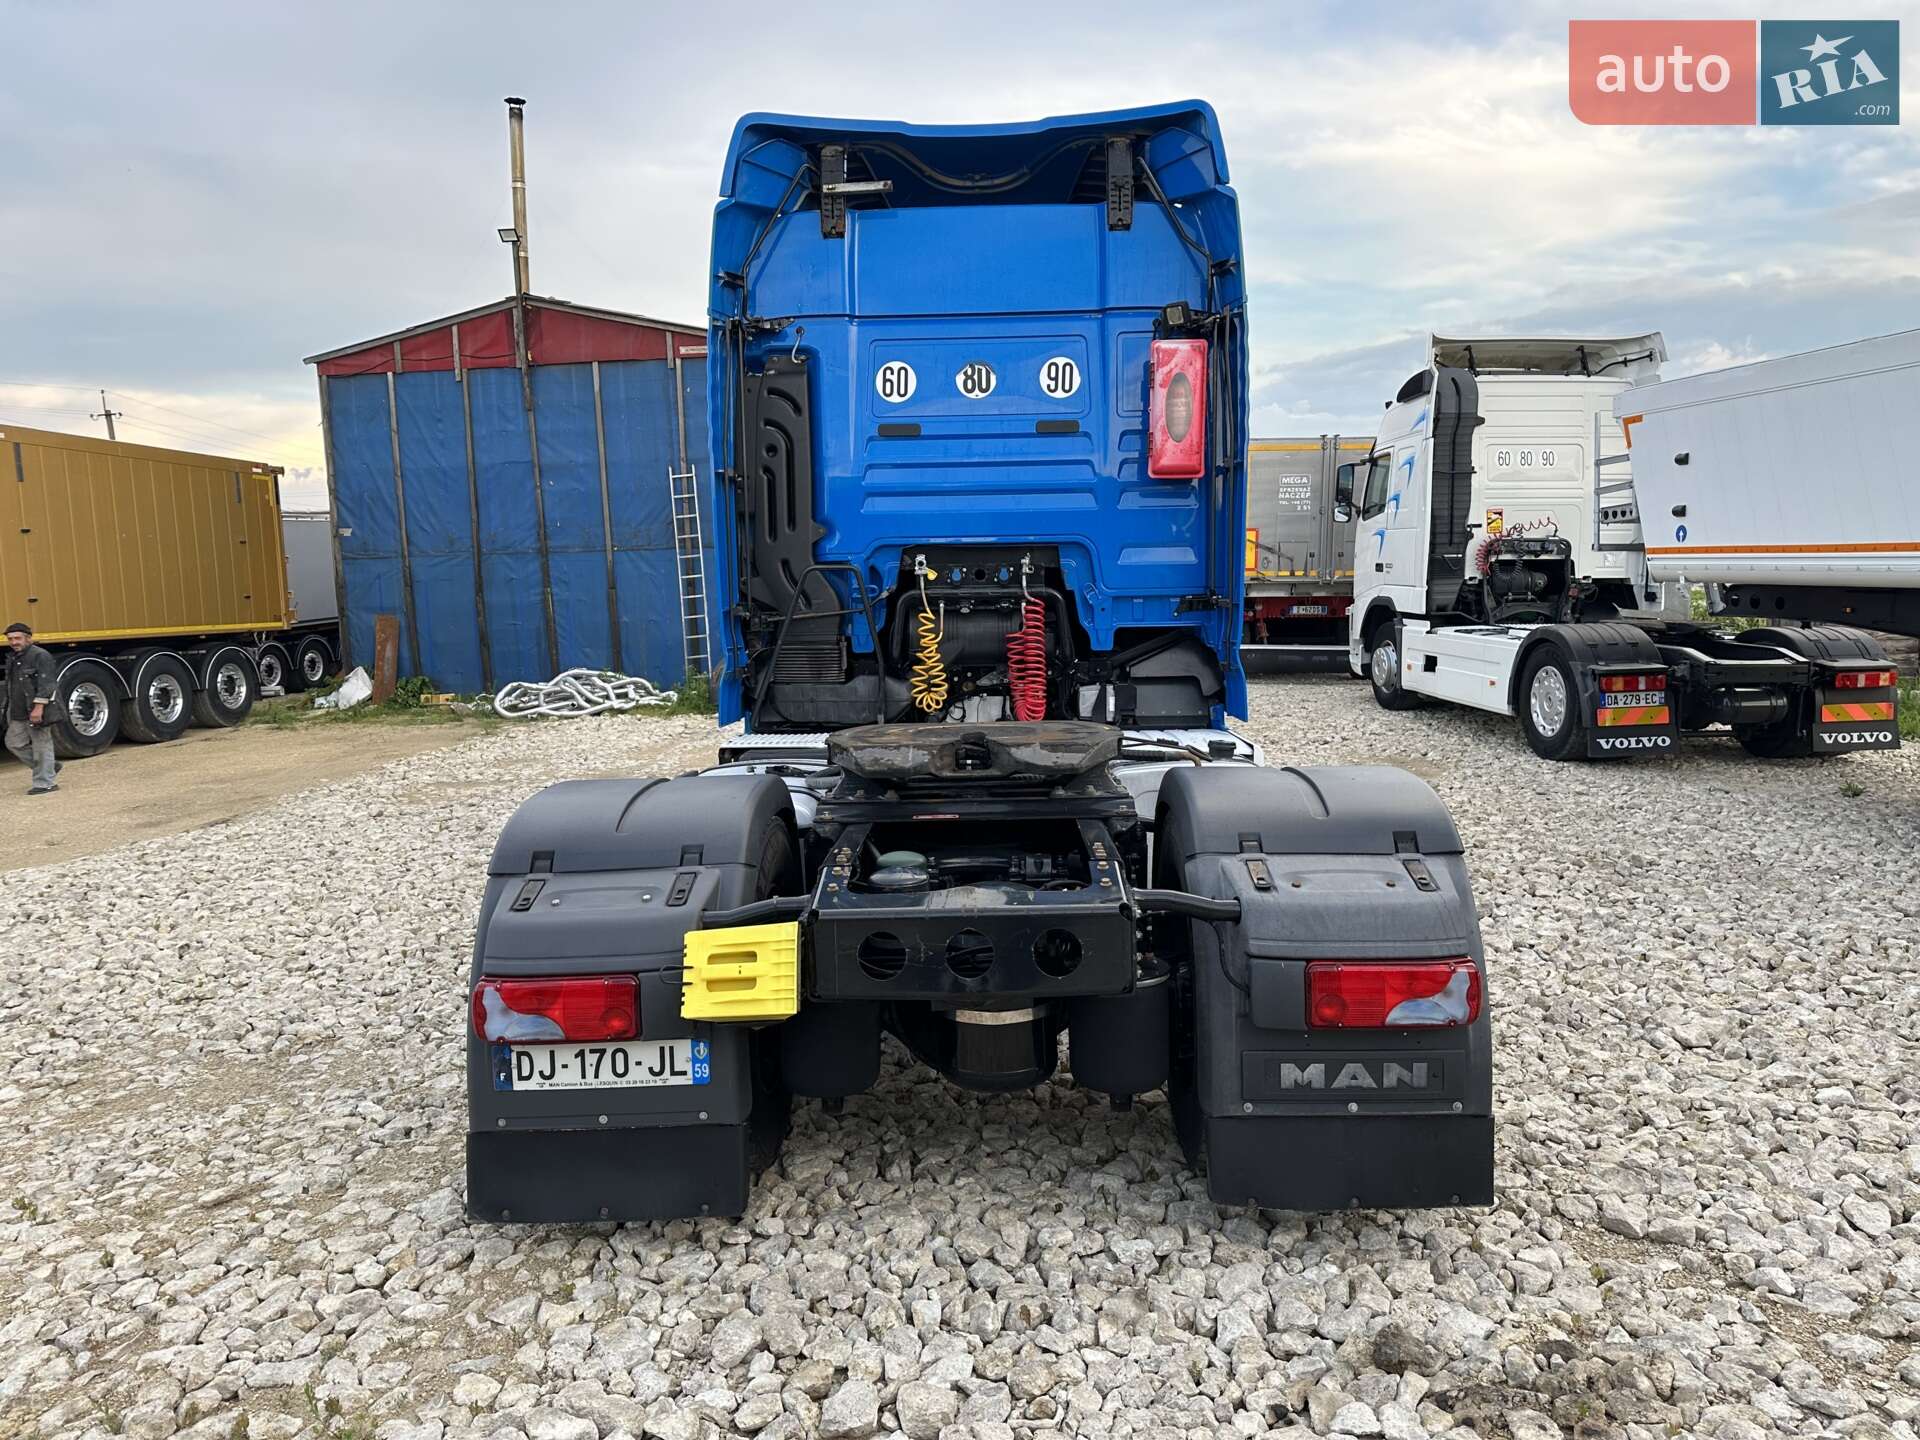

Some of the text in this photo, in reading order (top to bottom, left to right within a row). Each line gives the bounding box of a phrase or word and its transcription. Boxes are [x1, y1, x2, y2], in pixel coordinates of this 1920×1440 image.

[882, 361, 1074, 398] 60 80 90
[1497, 450, 1555, 467] 60 80 90
[1281, 476, 1308, 484] MEGA
[1606, 693, 1658, 706] DA-279-EC
[1596, 735, 1671, 750] VOLVO
[1820, 731, 1893, 744] VOLVO
[514, 1045, 688, 1082] DJ-170-JL
[693, 1063, 709, 1078] 59
[499, 1072, 506, 1081] F
[1280, 1062, 1429, 1089] MAN
